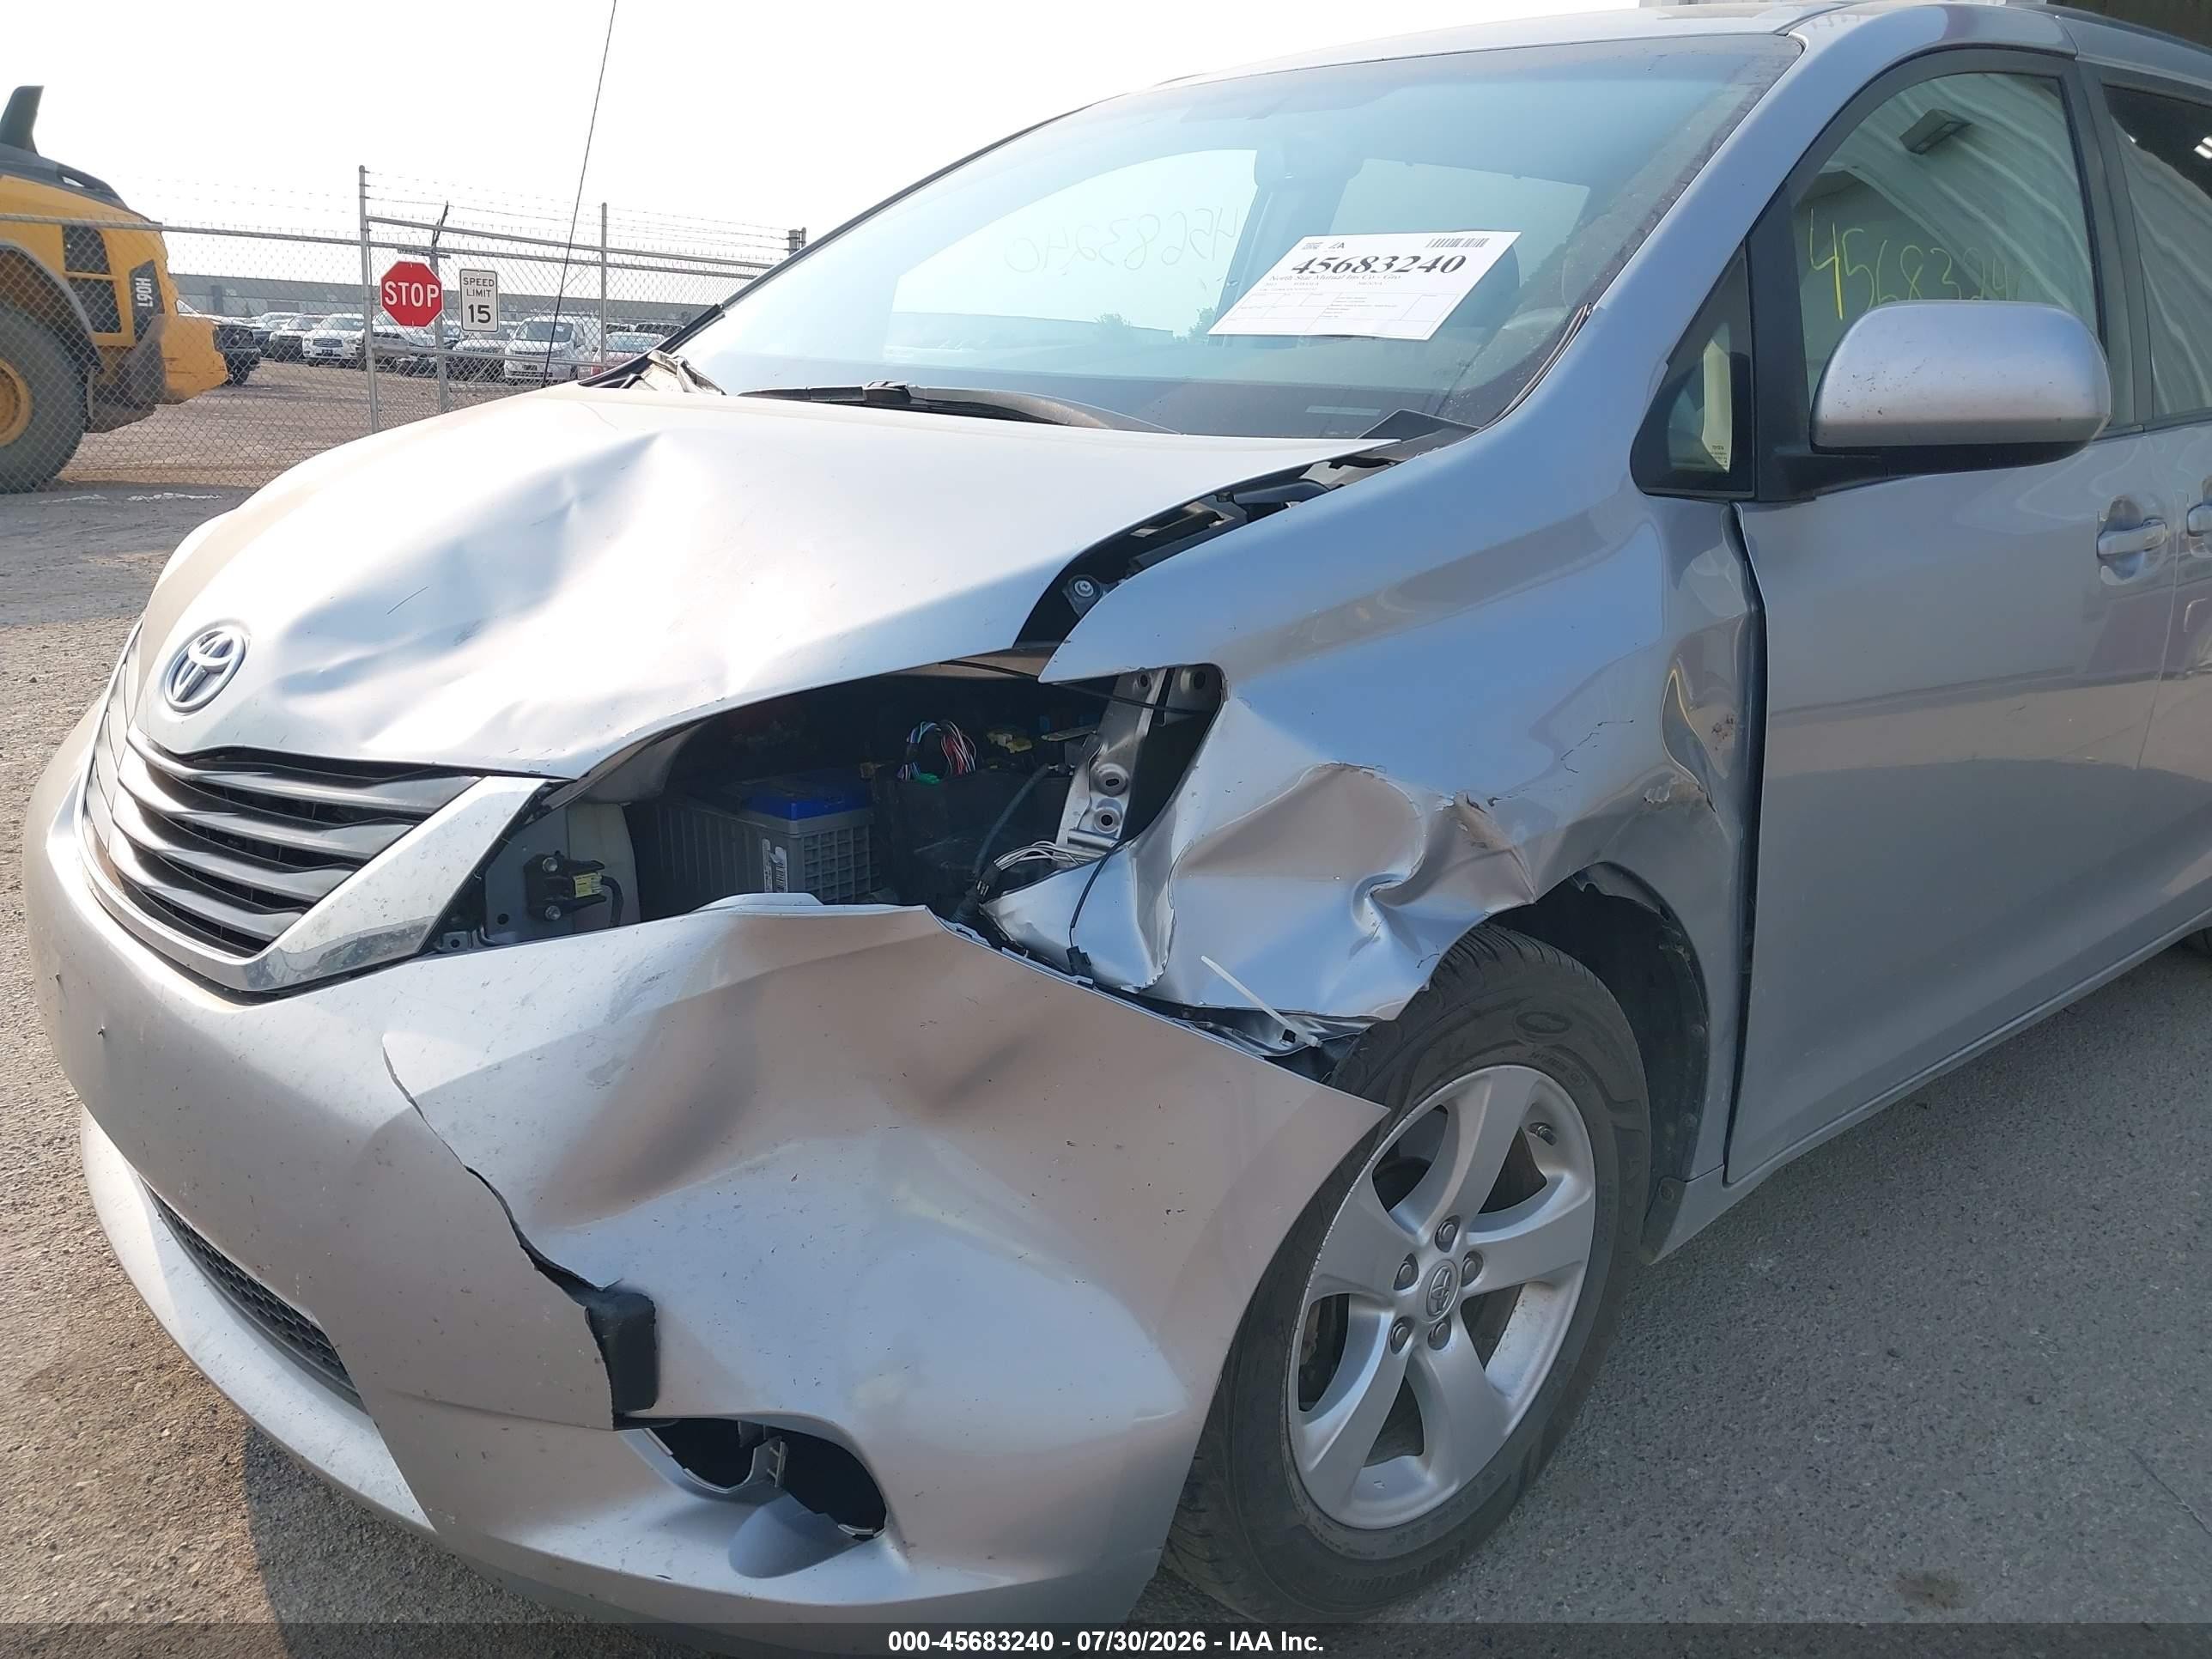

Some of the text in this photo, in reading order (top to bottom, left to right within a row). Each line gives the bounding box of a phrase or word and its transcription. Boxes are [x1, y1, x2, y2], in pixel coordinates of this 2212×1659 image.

[1291, 254, 1468, 275] 45683240
[135, 276, 154, 307] L90H
[463, 277, 495, 287] SPEED
[384, 281, 440, 307] STOP
[466, 288, 492, 298] LIMIT
[468, 303, 491, 324] 15
